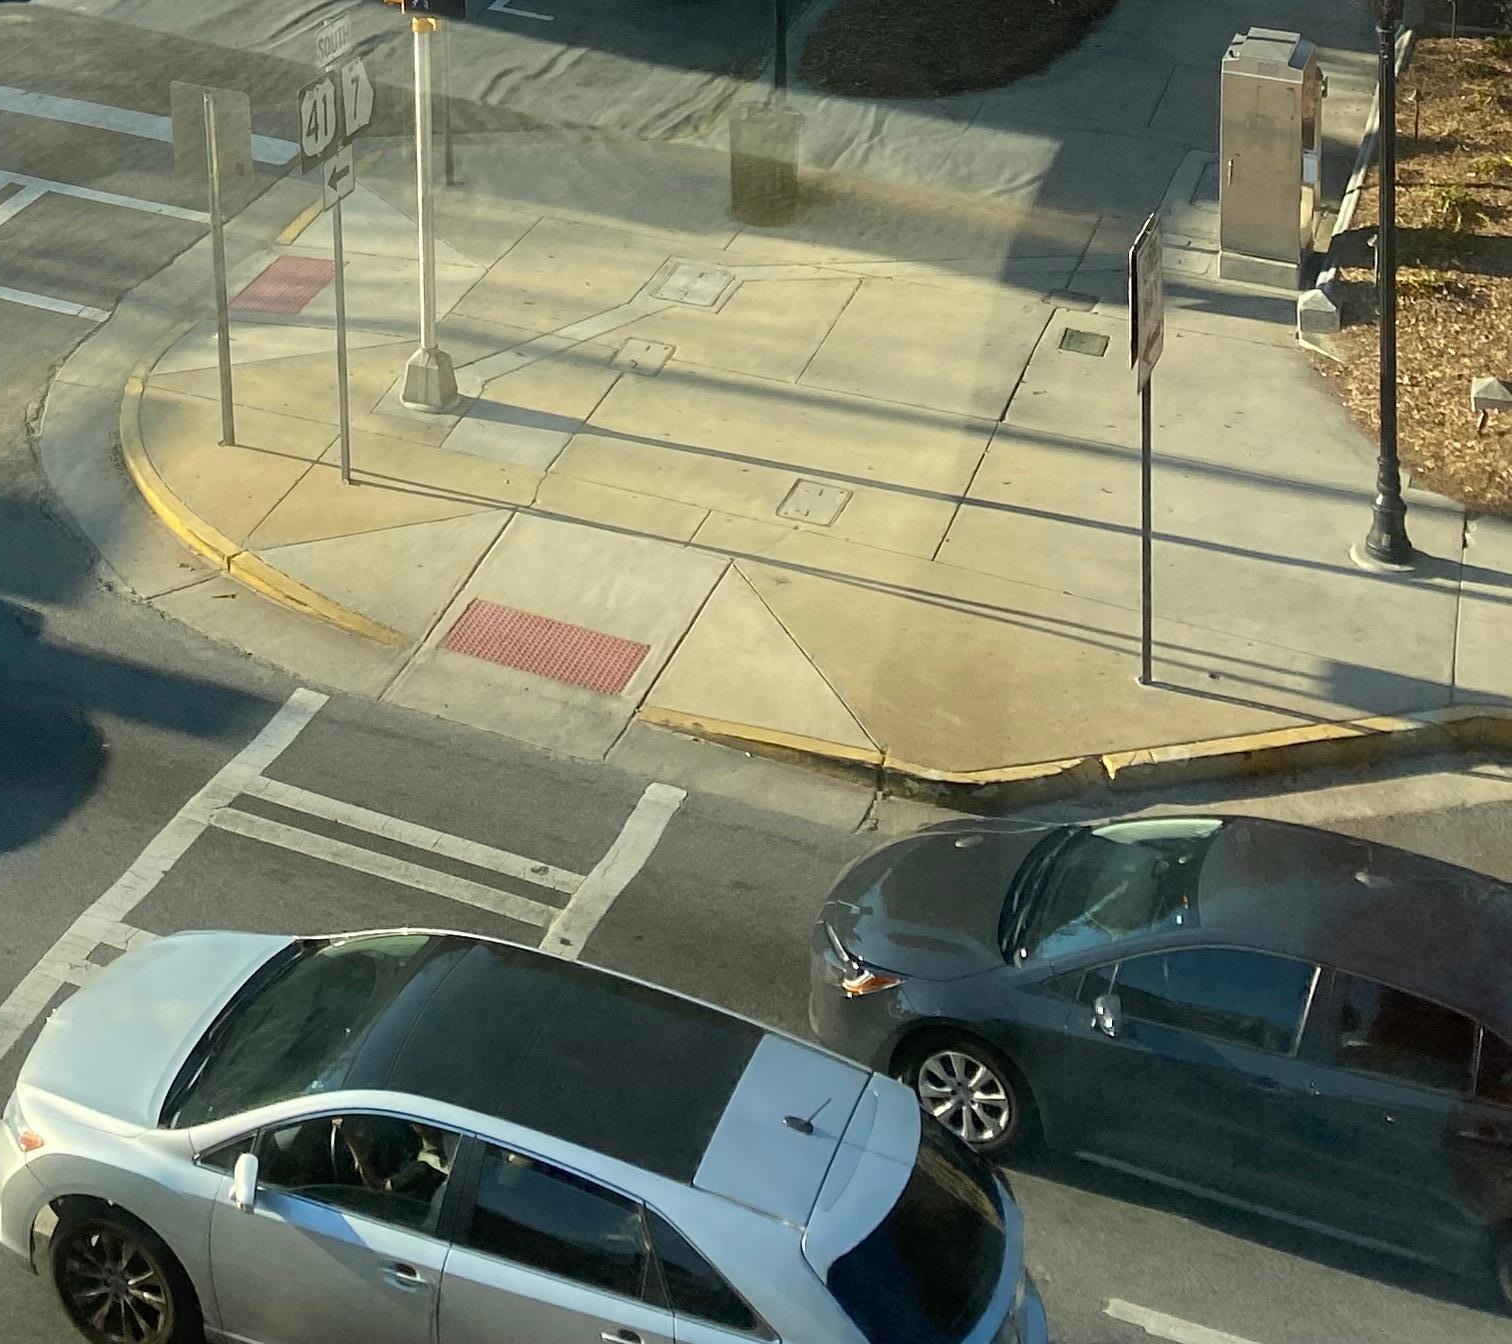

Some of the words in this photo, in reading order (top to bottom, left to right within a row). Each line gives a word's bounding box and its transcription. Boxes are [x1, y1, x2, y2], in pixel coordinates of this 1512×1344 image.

[317, 25, 351, 61] SOUTH
[305, 92, 328, 144] 41
[350, 74, 361, 121] 7
